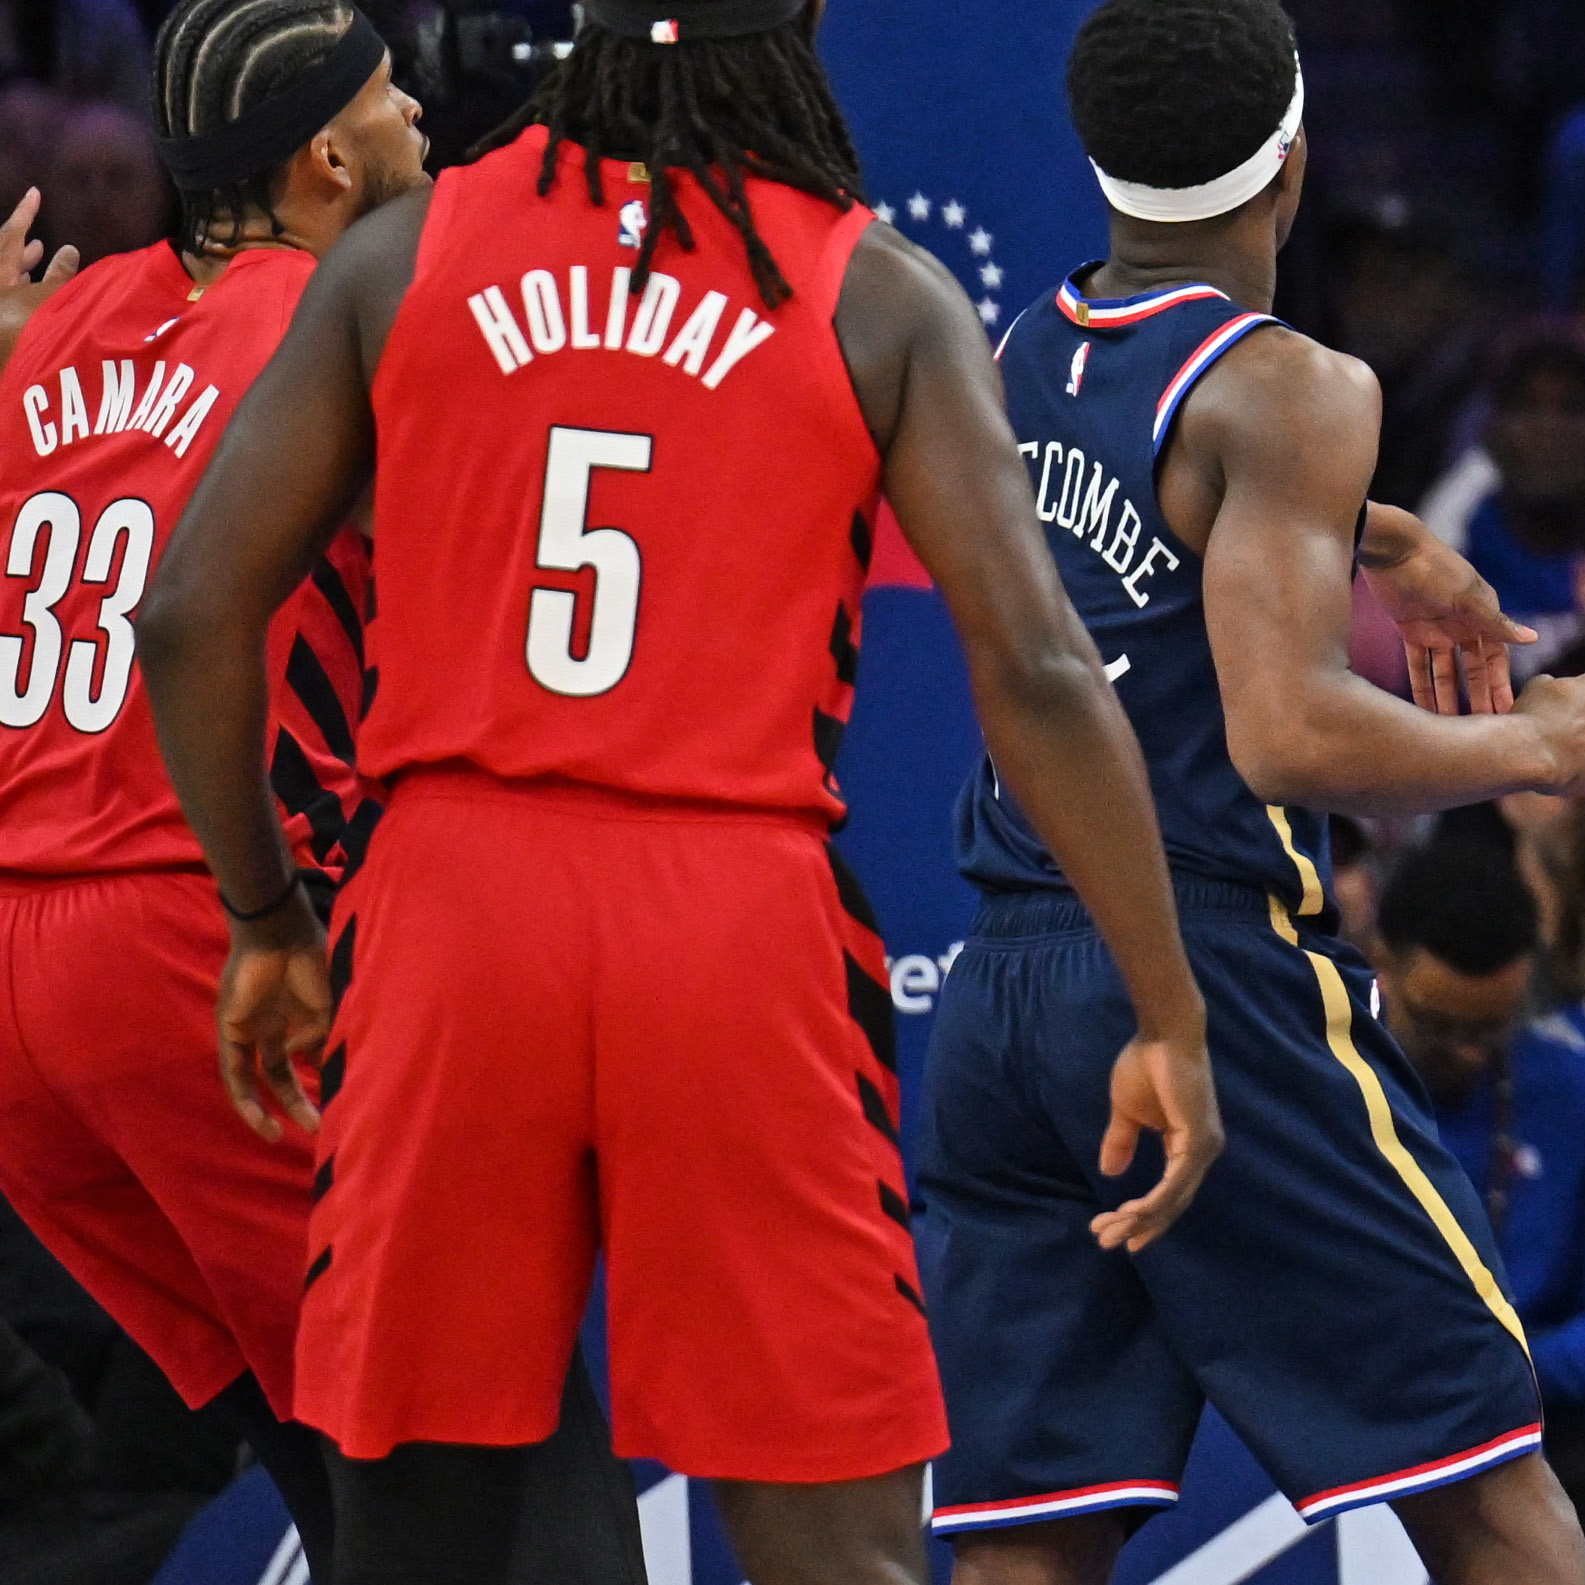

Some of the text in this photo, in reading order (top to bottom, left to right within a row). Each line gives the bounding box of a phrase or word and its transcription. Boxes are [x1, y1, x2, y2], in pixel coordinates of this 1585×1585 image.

[23, 359, 220, 459] CAMARA
[467, 265, 776, 390] HOLIDAY
[525, 424, 654, 699] 5
[1017, 441, 1181, 609] COMBE
[0, 490, 154, 733] 33
